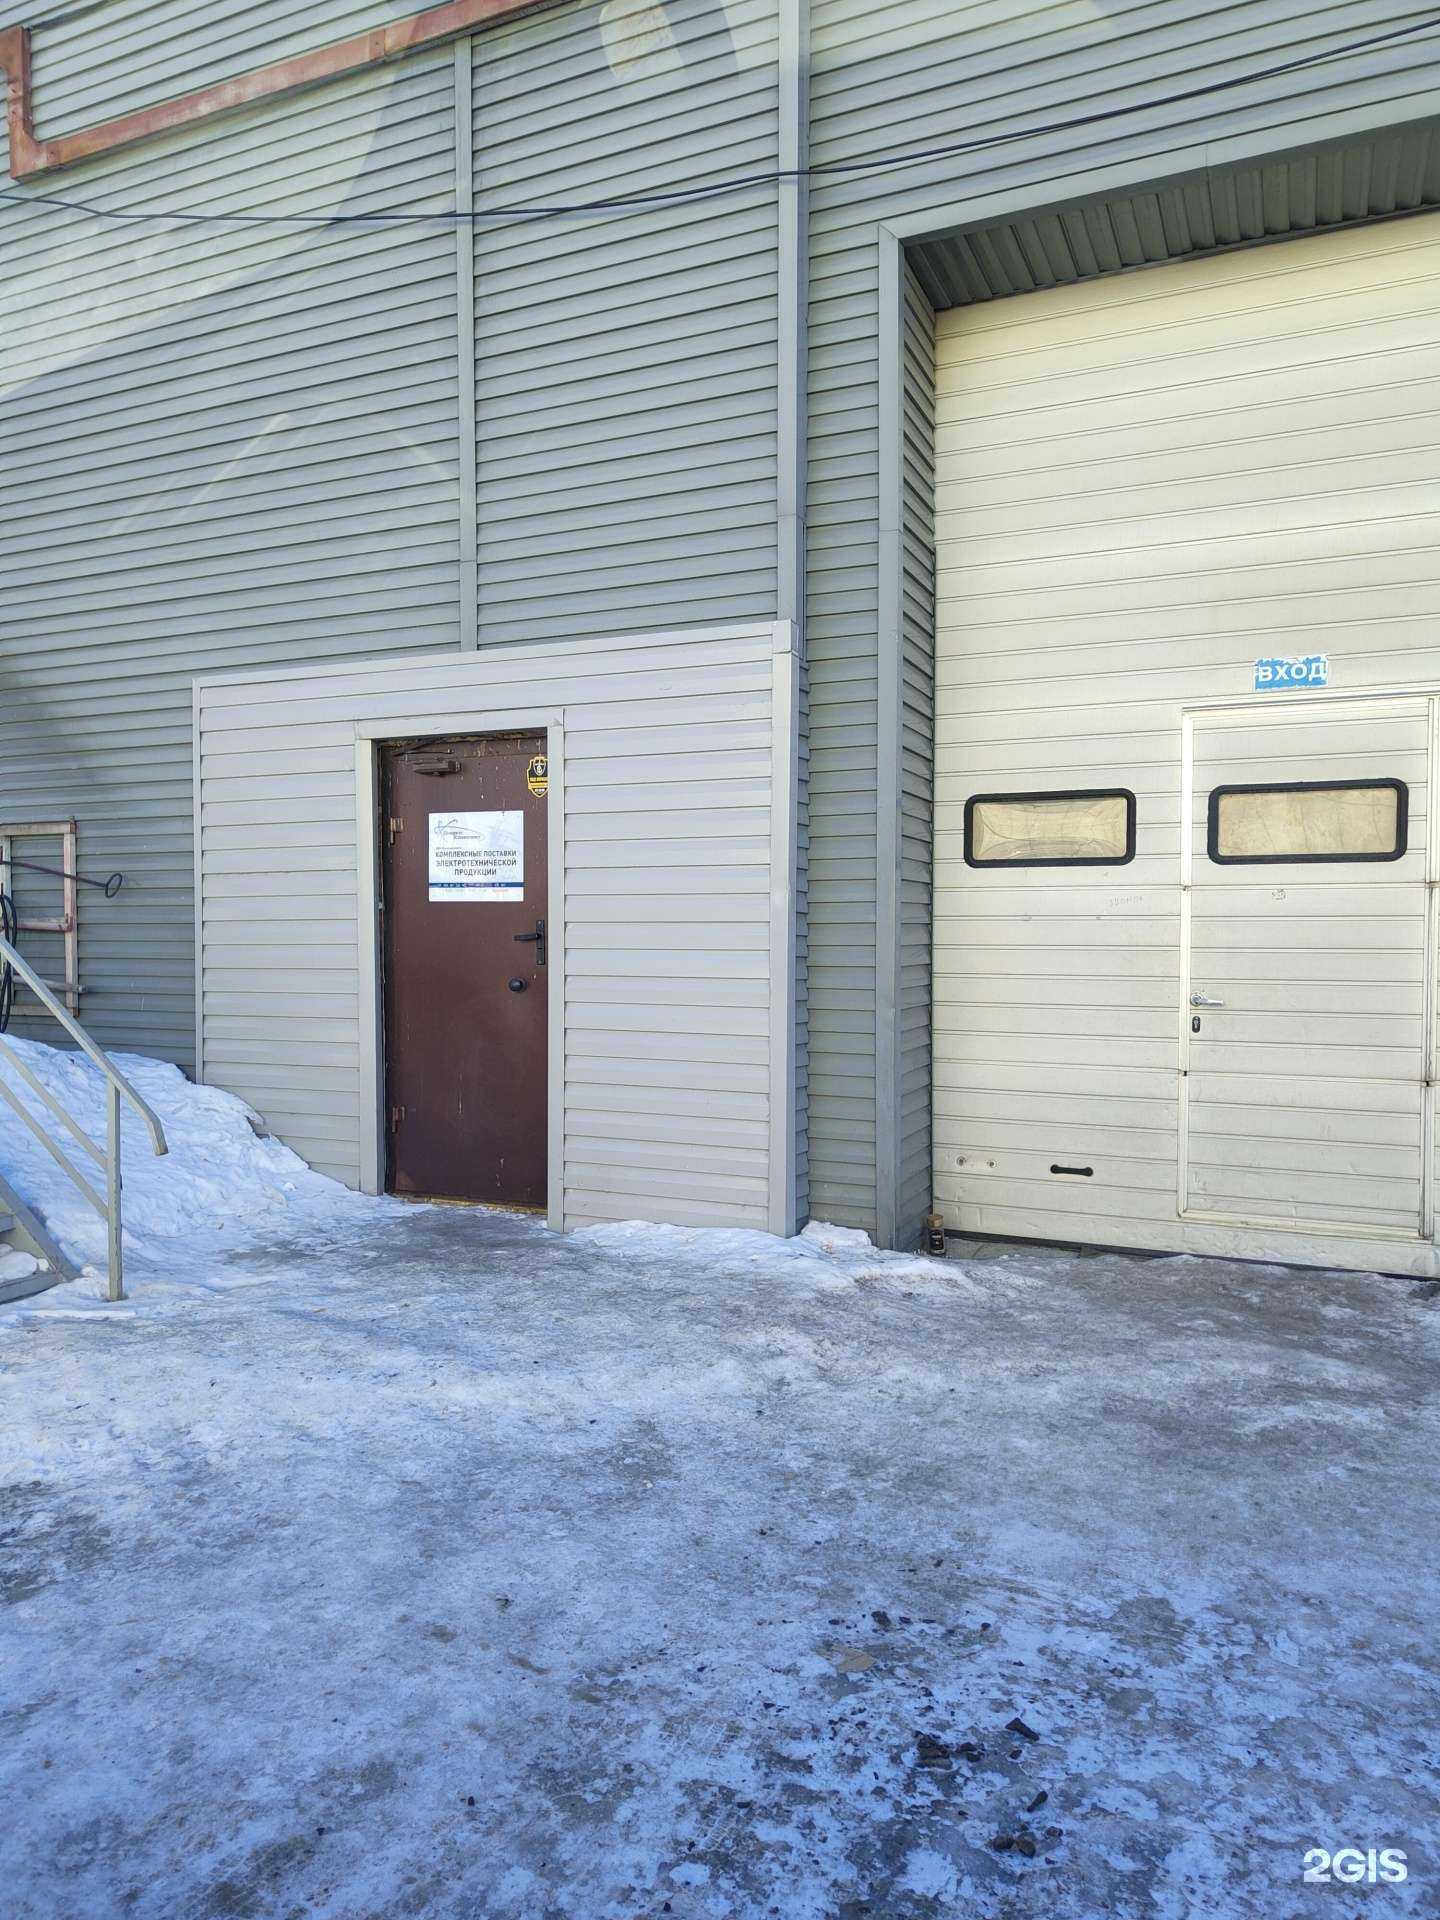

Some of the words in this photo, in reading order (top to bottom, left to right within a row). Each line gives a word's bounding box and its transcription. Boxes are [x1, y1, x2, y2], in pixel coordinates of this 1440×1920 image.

[1258, 662, 1328, 682] ВХОД
[435, 850, 482, 858] КОМПЛЕКСНЫЕ
[483, 850, 517, 858] ПОСТАВКИ
[436, 858, 517, 867] ЭЛЕКТРОТЕХНИЧЕСКОЙ
[454, 868, 497, 877] ПРОДУКЦИИ
